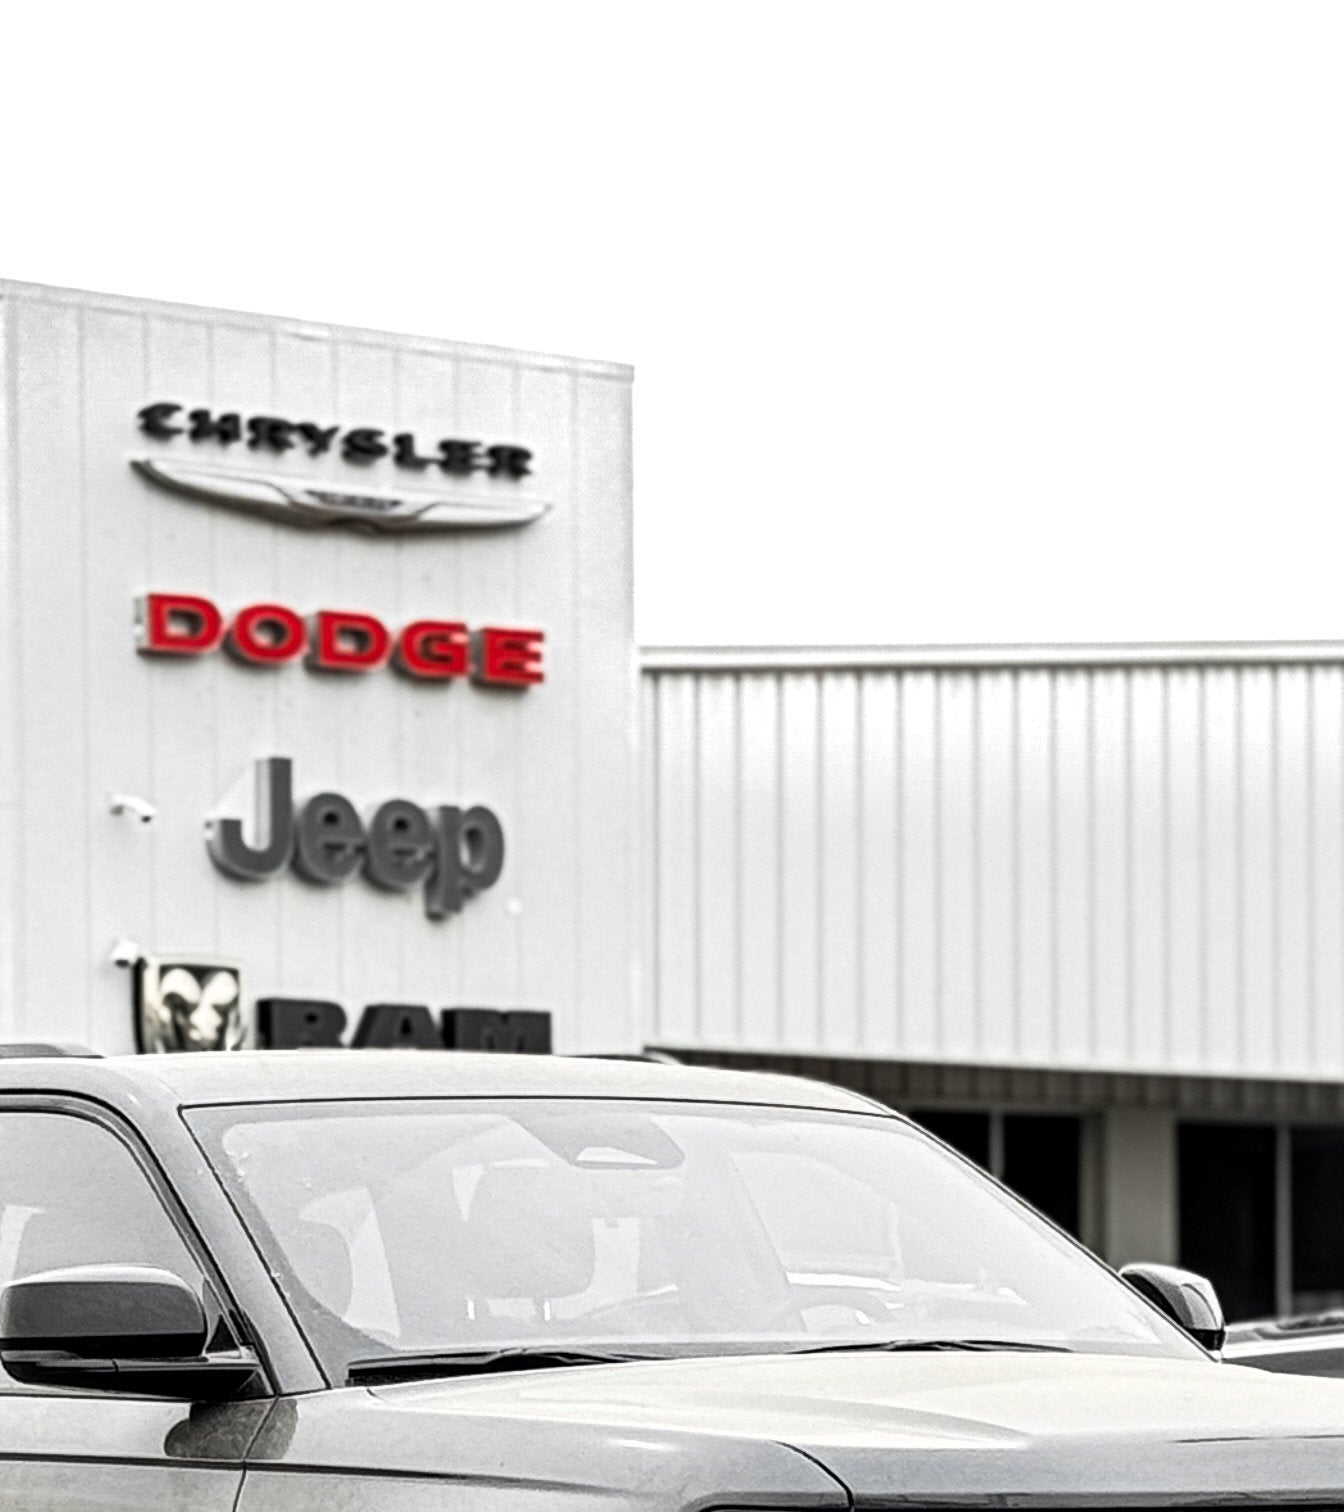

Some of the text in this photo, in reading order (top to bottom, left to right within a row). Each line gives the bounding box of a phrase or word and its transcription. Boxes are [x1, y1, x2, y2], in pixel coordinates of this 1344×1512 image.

[136, 402, 534, 479] CHRYSLER
[136, 592, 546, 696] DODGE
[205, 756, 505, 922] Jeep
[256, 996, 552, 1054] RAM
